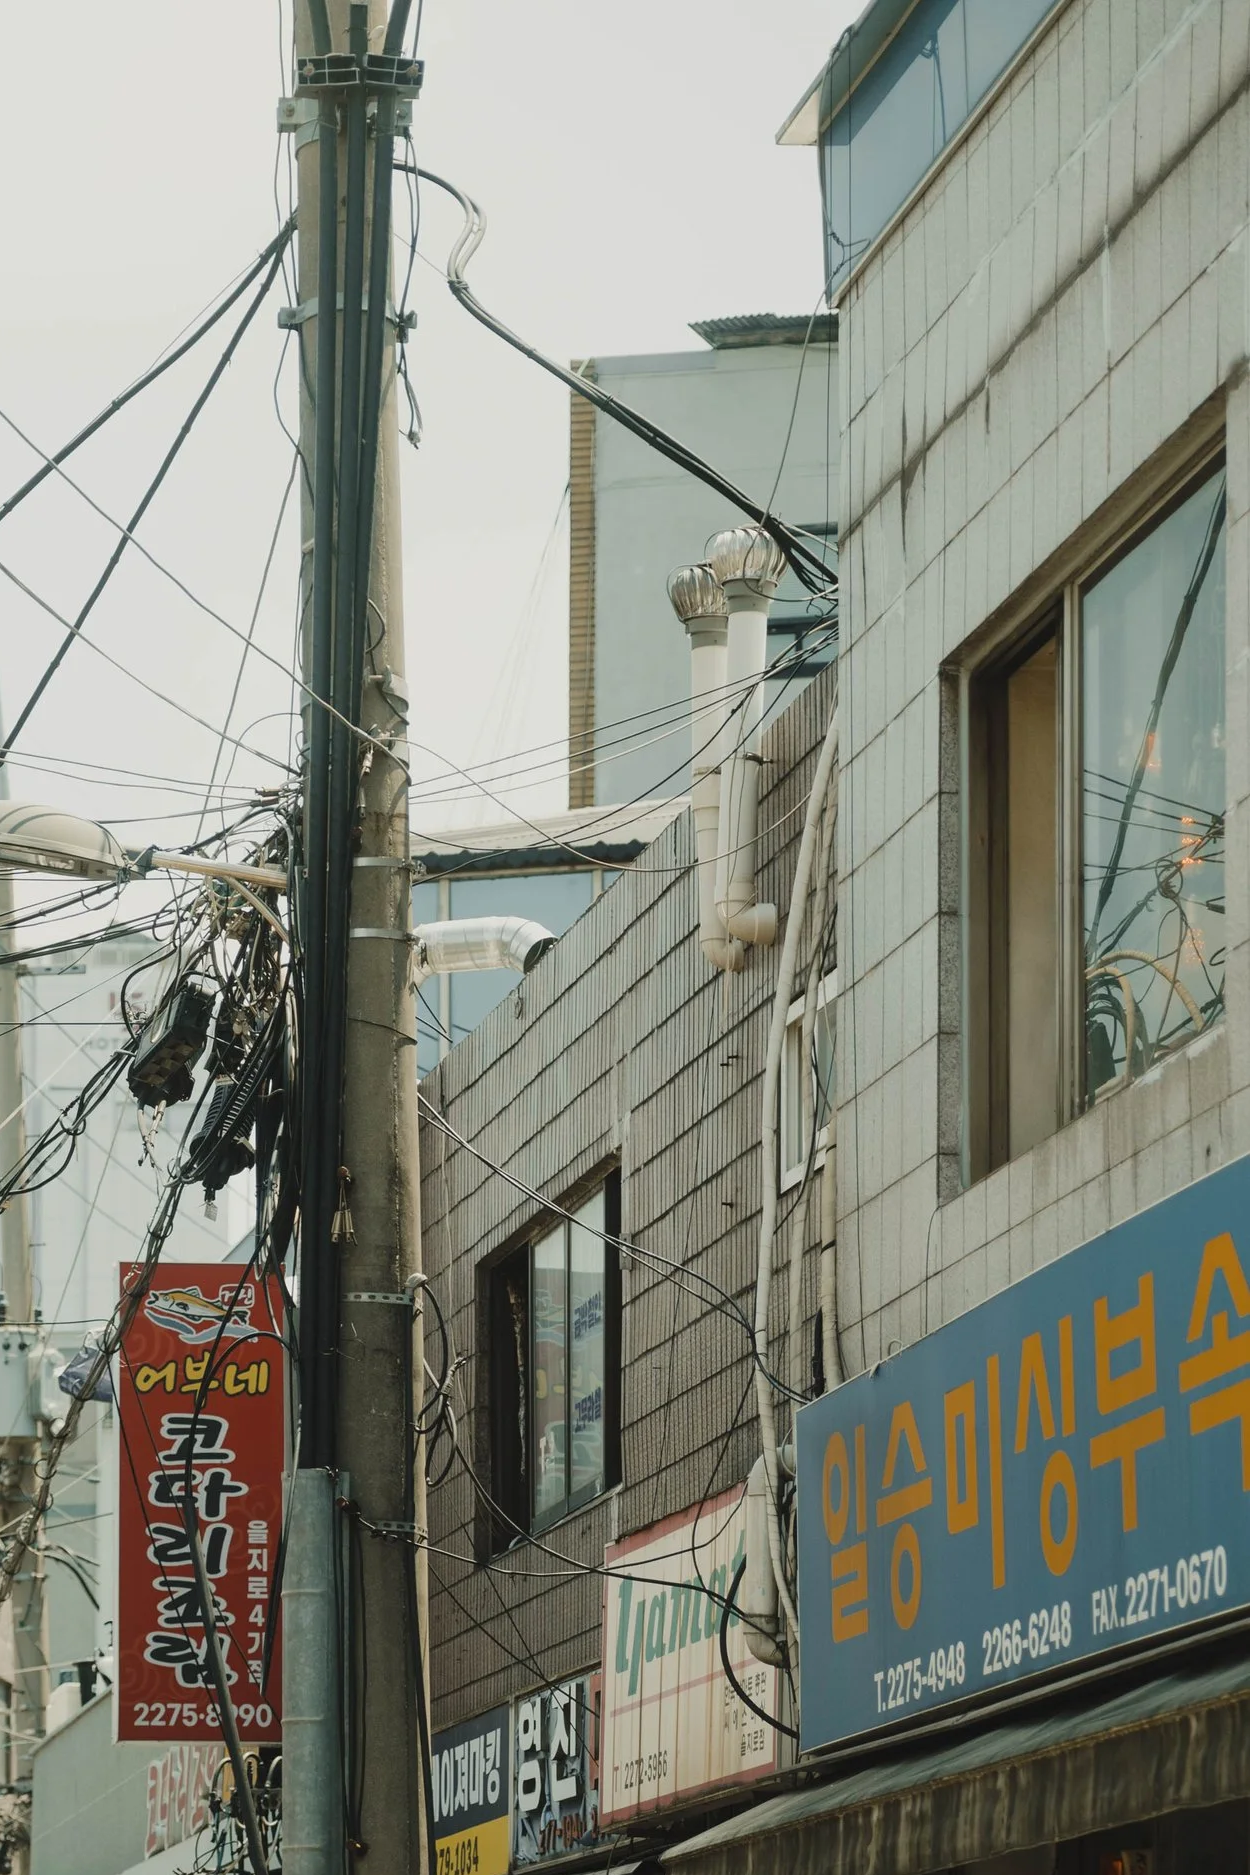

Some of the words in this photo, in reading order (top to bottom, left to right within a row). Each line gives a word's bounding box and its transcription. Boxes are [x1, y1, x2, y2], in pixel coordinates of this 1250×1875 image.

[135, 1350, 271, 1408] 어부네
[874, 1641, 965, 1713] T.2275-4948
[982, 1600, 1071, 1676] 2266-6248
[1092, 1545, 1227, 1636] FAX.2271-0670
[518, 1682, 578, 1812] 영진
